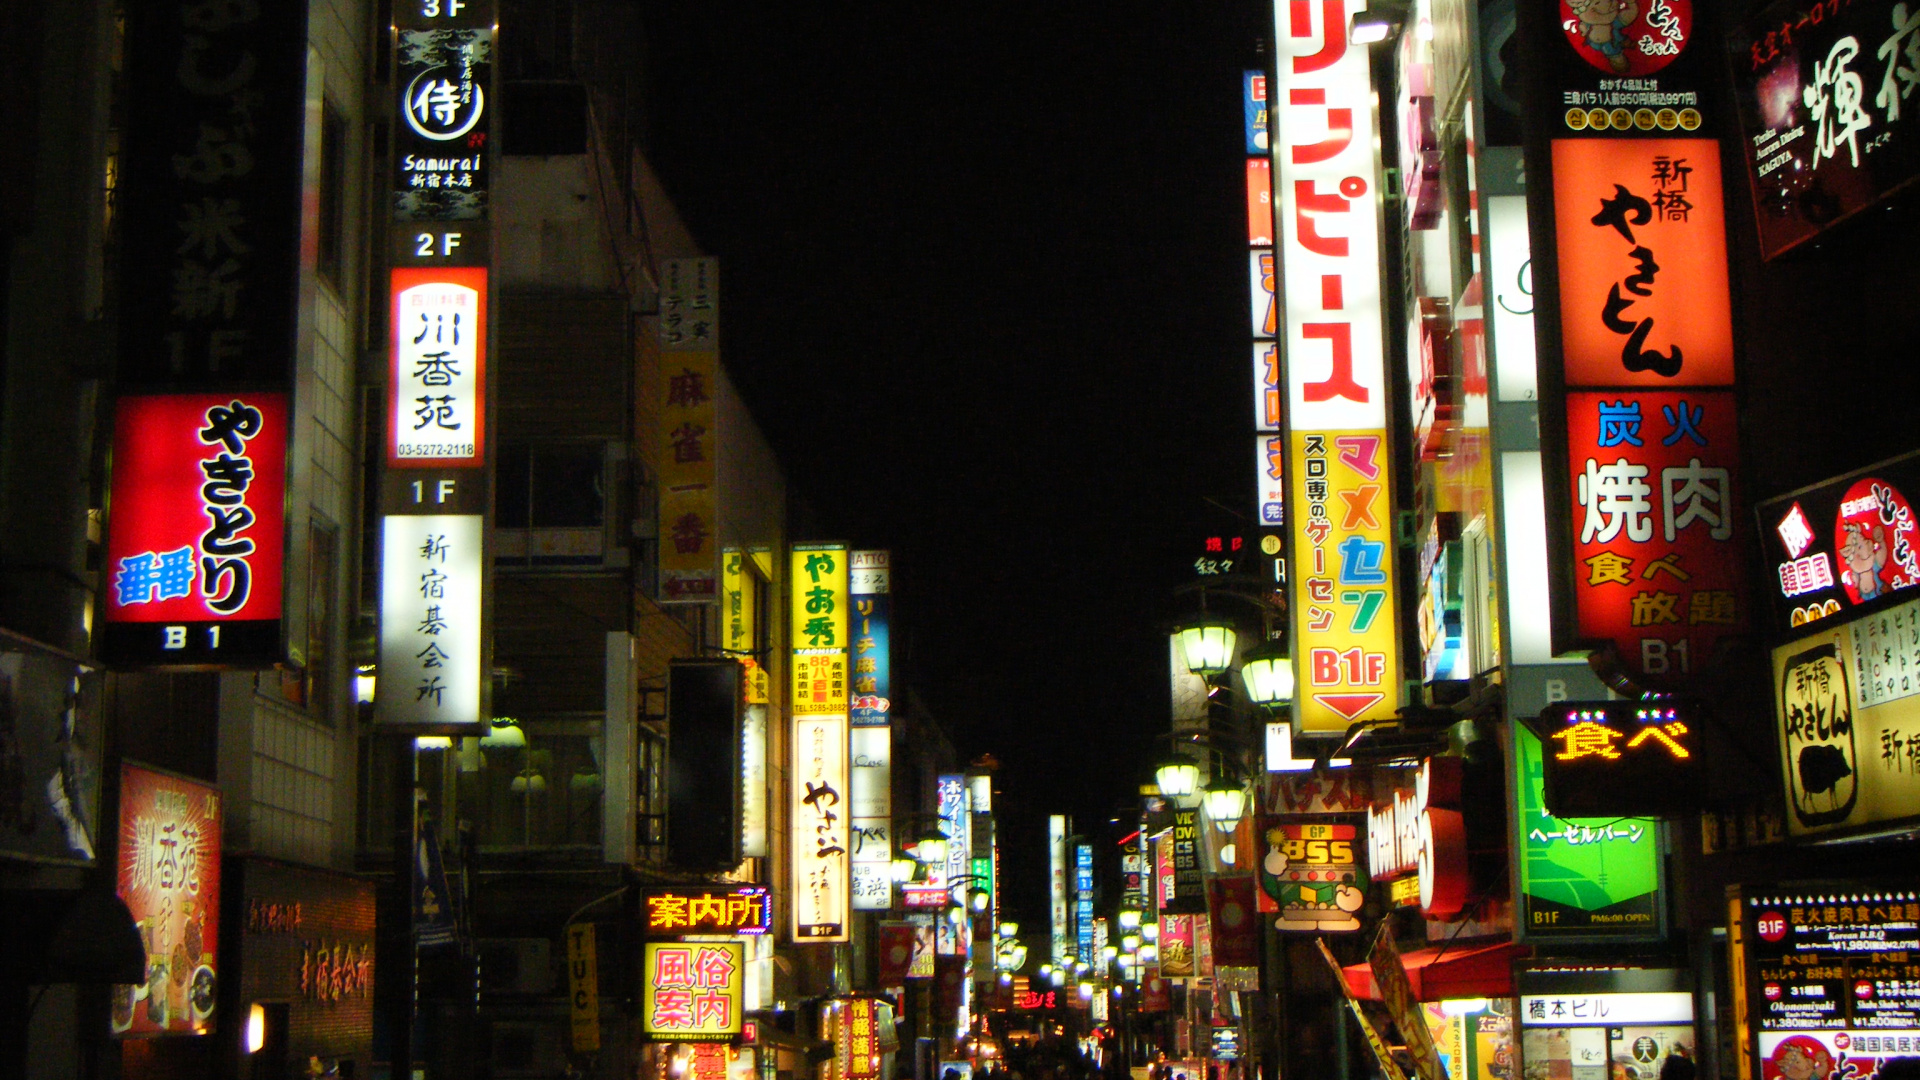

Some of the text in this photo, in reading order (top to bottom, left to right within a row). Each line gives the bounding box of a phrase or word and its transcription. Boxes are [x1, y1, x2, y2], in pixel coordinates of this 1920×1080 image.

[412, 78, 462, 127] 侍
[404, 153, 481, 171] Samurai
[410, 173, 473, 188] 新宿本店
[1758, 150, 1793, 177] KAGUYA
[1651, 156, 1693, 223] 新橋
[415, 233, 462, 257] 2F
[1591, 183, 1684, 378] やきとん
[411, 293, 468, 307] 四川料理
[413, 312, 461, 431] 川香苑
[1597, 400, 1708, 448] 炭火
[398, 443, 474, 456] 03-5272-2118
[667, 369, 707, 555] 麻雀一番
[199, 400, 264, 615] やきとり
[413, 479, 456, 503] 1F
[1577, 457, 1733, 545] 焼肉
[1304, 434, 1334, 633] スロ専のゲーセン
[1334, 434, 1387, 634] マメセン
[1581, 550, 1692, 587] 食べ
[802, 553, 837, 647] やお秀
[1630, 590, 1738, 627] 放題
[165, 625, 211, 649] B1
[417, 534, 450, 708] 新宿碁会所
[810, 656, 830, 667] 88
[855, 599, 878, 693] リーチ麻雀
[1641, 639, 1689, 676] B1
[1310, 646, 1386, 688] B1F
[1795, 660, 1831, 701] 新橋
[1787, 693, 1850, 744] やきとん
[1551, 721, 1690, 761] 食べ
[1174, 840, 1194, 854] CS
[1309, 825, 1326, 839] GP
[1529, 824, 1645, 846] ヘーゼルバーン
[1281, 839, 1355, 864] BSS
[648, 892, 763, 928] 案内所
[1533, 911, 1559, 924] B1F
[1625, 913, 1651, 923] OPEN
[1758, 920, 1784, 935] B1F
[811, 925, 833, 936] B1F
[1827, 931, 1859, 941] Korean
[652, 947, 735, 990] 風俗
[652, 989, 732, 1030] 案内
[1528, 998, 1610, 1020] 橋本ビル
[1769, 1000, 1836, 1013] Okonomiyaki
